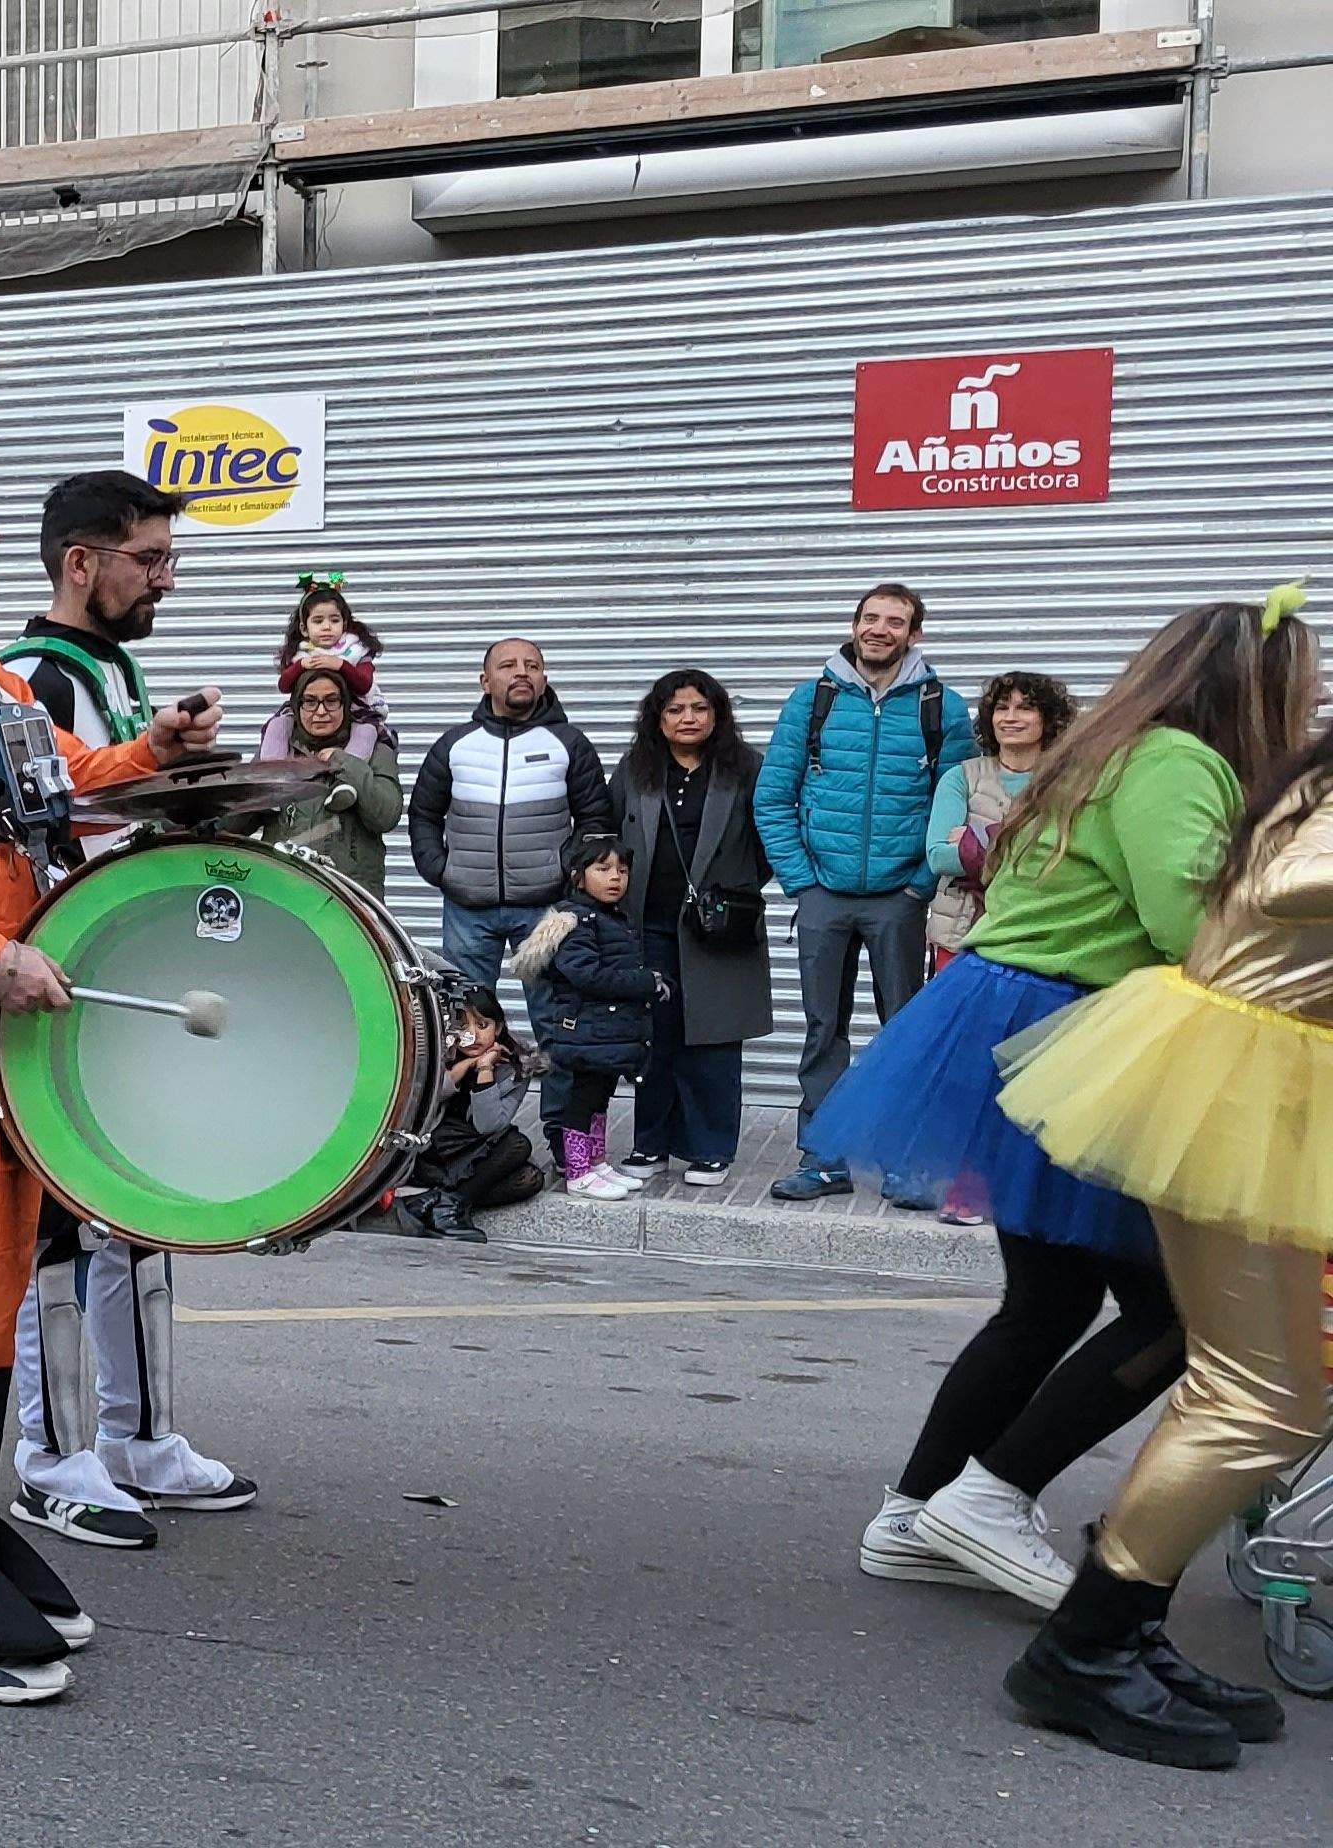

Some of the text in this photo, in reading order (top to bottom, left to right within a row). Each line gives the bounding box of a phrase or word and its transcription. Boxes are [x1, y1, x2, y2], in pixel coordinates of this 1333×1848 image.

[231, 431, 264, 441] técnicas
[874, 432, 1082, 474] Añaños
[921, 472, 1080, 494] Constructora
[187, 499, 291, 513] electricidad y climatización
